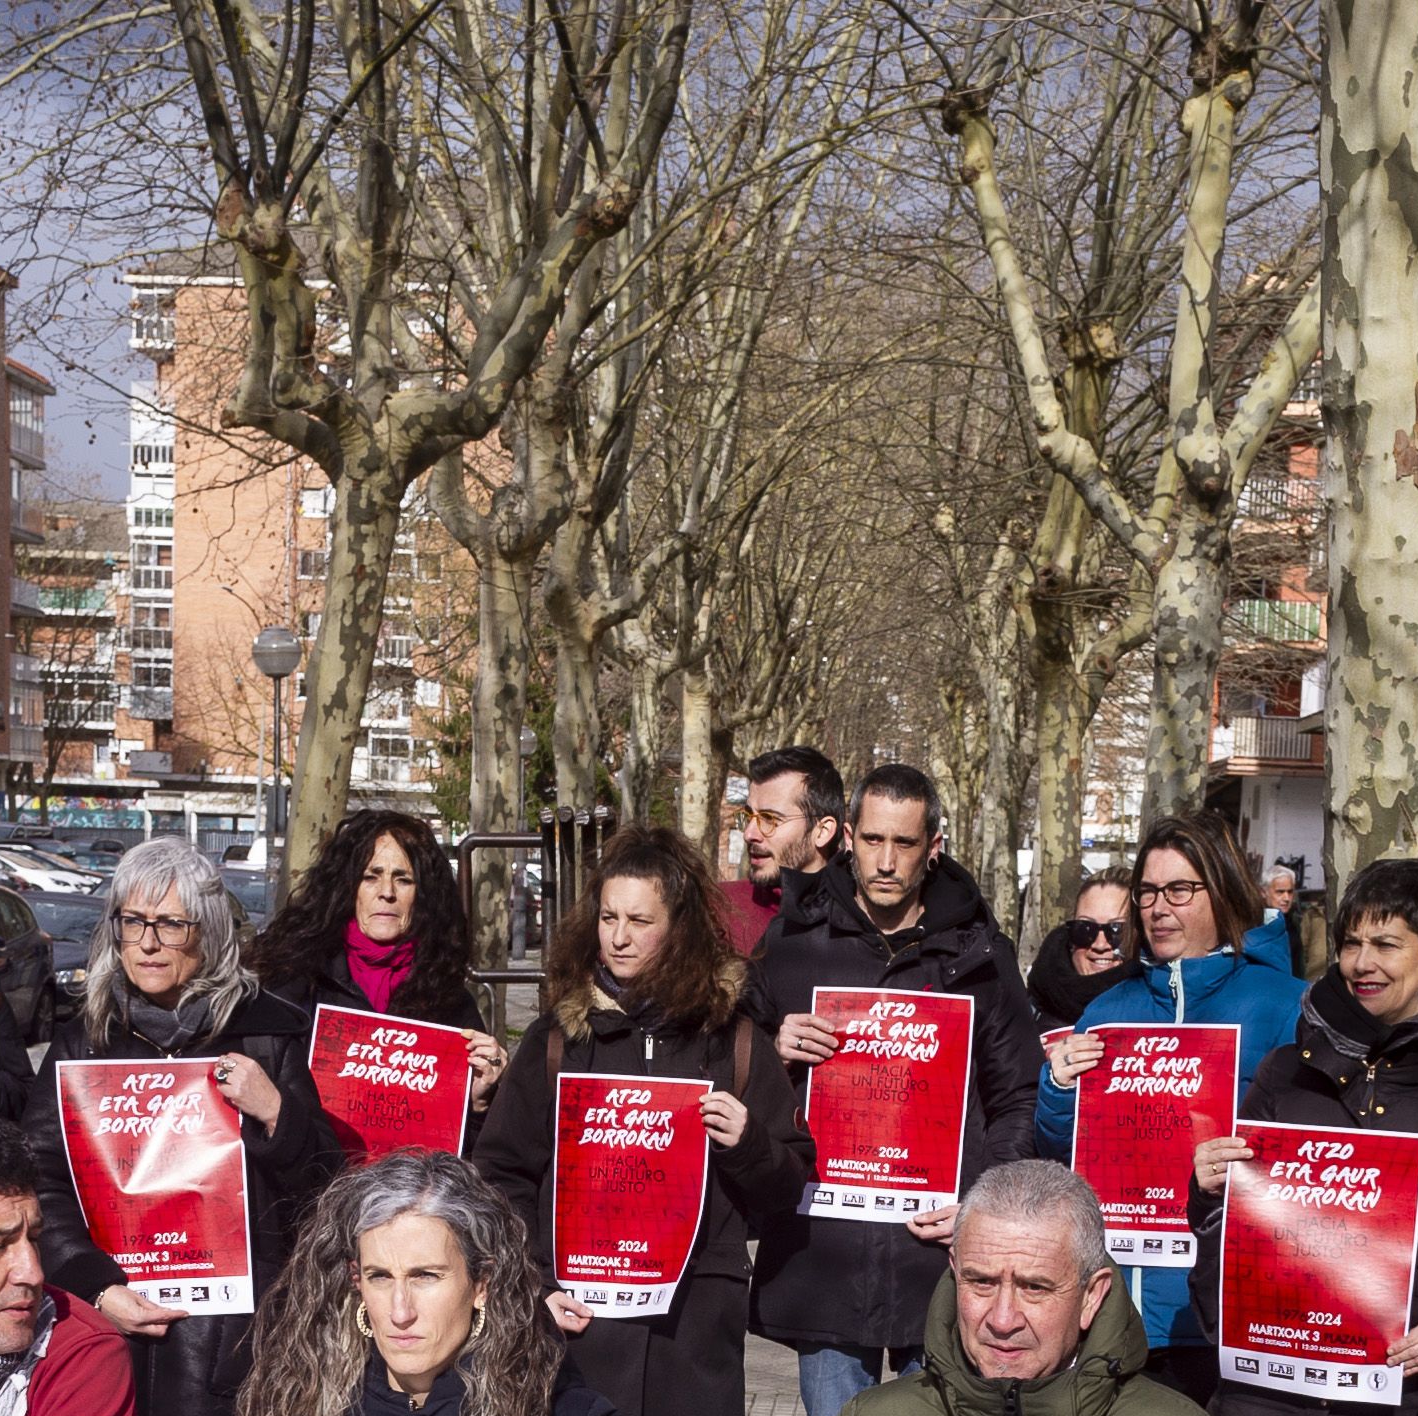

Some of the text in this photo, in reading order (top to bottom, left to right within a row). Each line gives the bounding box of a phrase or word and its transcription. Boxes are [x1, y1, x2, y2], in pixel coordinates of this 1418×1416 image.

[869, 1001, 916, 1019] ATZO
[371, 1027, 418, 1047] ATZO
[846, 1020, 938, 1042] ETA GAUR
[839, 1039, 939, 1063] BORROKAN
[1133, 1037, 1179, 1055] ATZO
[346, 1043, 438, 1073] ETA GAUR
[1111, 1057, 1202, 1075] ETA GAUR
[123, 1073, 176, 1092] ATZO
[337, 1062, 439, 1093] BORROKAN
[1105, 1074, 1203, 1097] BORROKAN
[98, 1093, 202, 1115] ETA GAUR
[605, 1088, 652, 1107] ATZO
[93, 1112, 205, 1137] BORROKAN
[584, 1108, 672, 1130] ETA GAUR
[578, 1127, 674, 1151] BORROKAN
[878, 1147, 909, 1159] 2024
[1297, 1140, 1355, 1163] ATZO
[827, 1158, 890, 1172] MARTXOAK 3
[1270, 1161, 1381, 1189] ETA GAUR
[1145, 1188, 1175, 1200] 2024
[1264, 1184, 1382, 1213] BORROKAN
[1149, 1205, 1156, 1214] 3
[154, 1232, 188, 1245] 2024
[618, 1241, 648, 1253] 2024
[162, 1251, 169, 1262] 3
[567, 1254, 630, 1267] MARTXOAK 3
[1307, 1312, 1342, 1326] 2024
[1248, 1323, 1320, 1341] MARTXOAK 3
